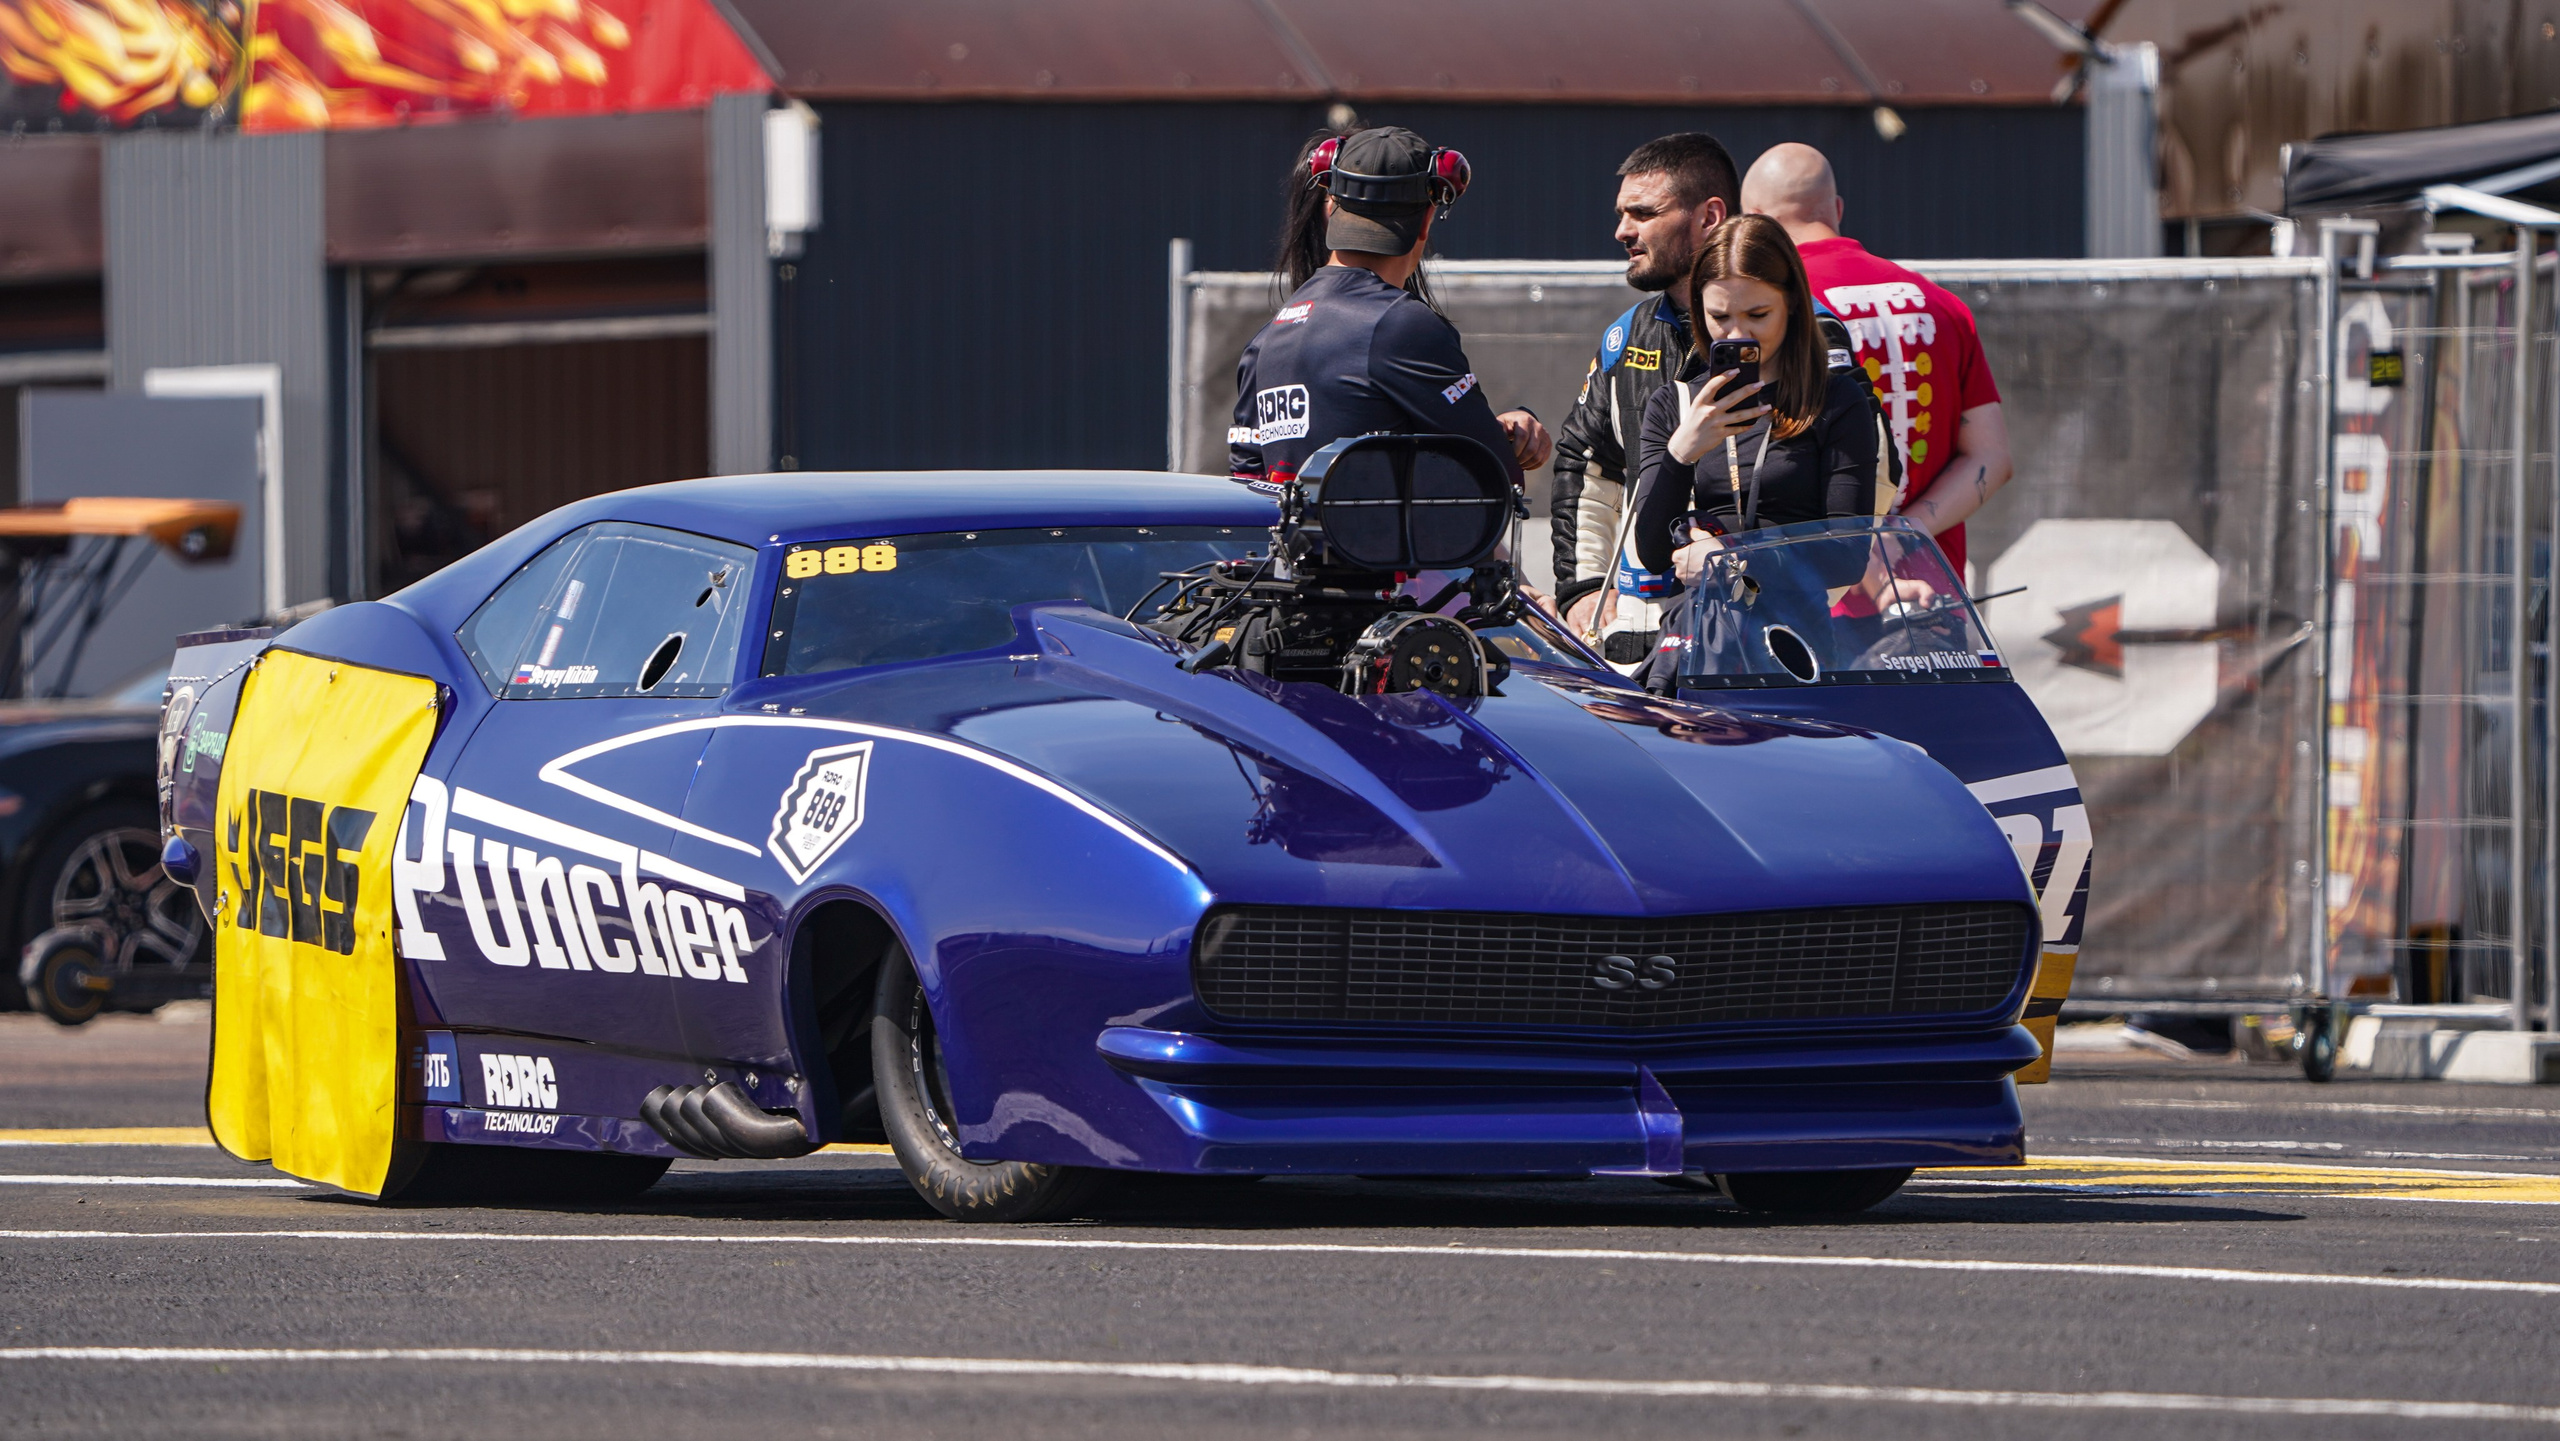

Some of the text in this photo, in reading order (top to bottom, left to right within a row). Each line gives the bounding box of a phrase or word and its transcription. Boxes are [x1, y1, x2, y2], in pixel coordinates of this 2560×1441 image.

[786, 544, 898, 579] 888
[528, 665, 599, 689] Sergey Nikitin
[1880, 650, 1981, 674] Sergey Nikitin
[802, 787, 847, 833] 888
[227, 788, 378, 957] JEGS
[392, 773, 753, 983] Puncher
[1593, 955, 1676, 990] SS
[911, 984, 924, 1074] RACIN
[479, 1053, 559, 1110] RDRC
[484, 1111, 560, 1135] TECHNOLOGY
